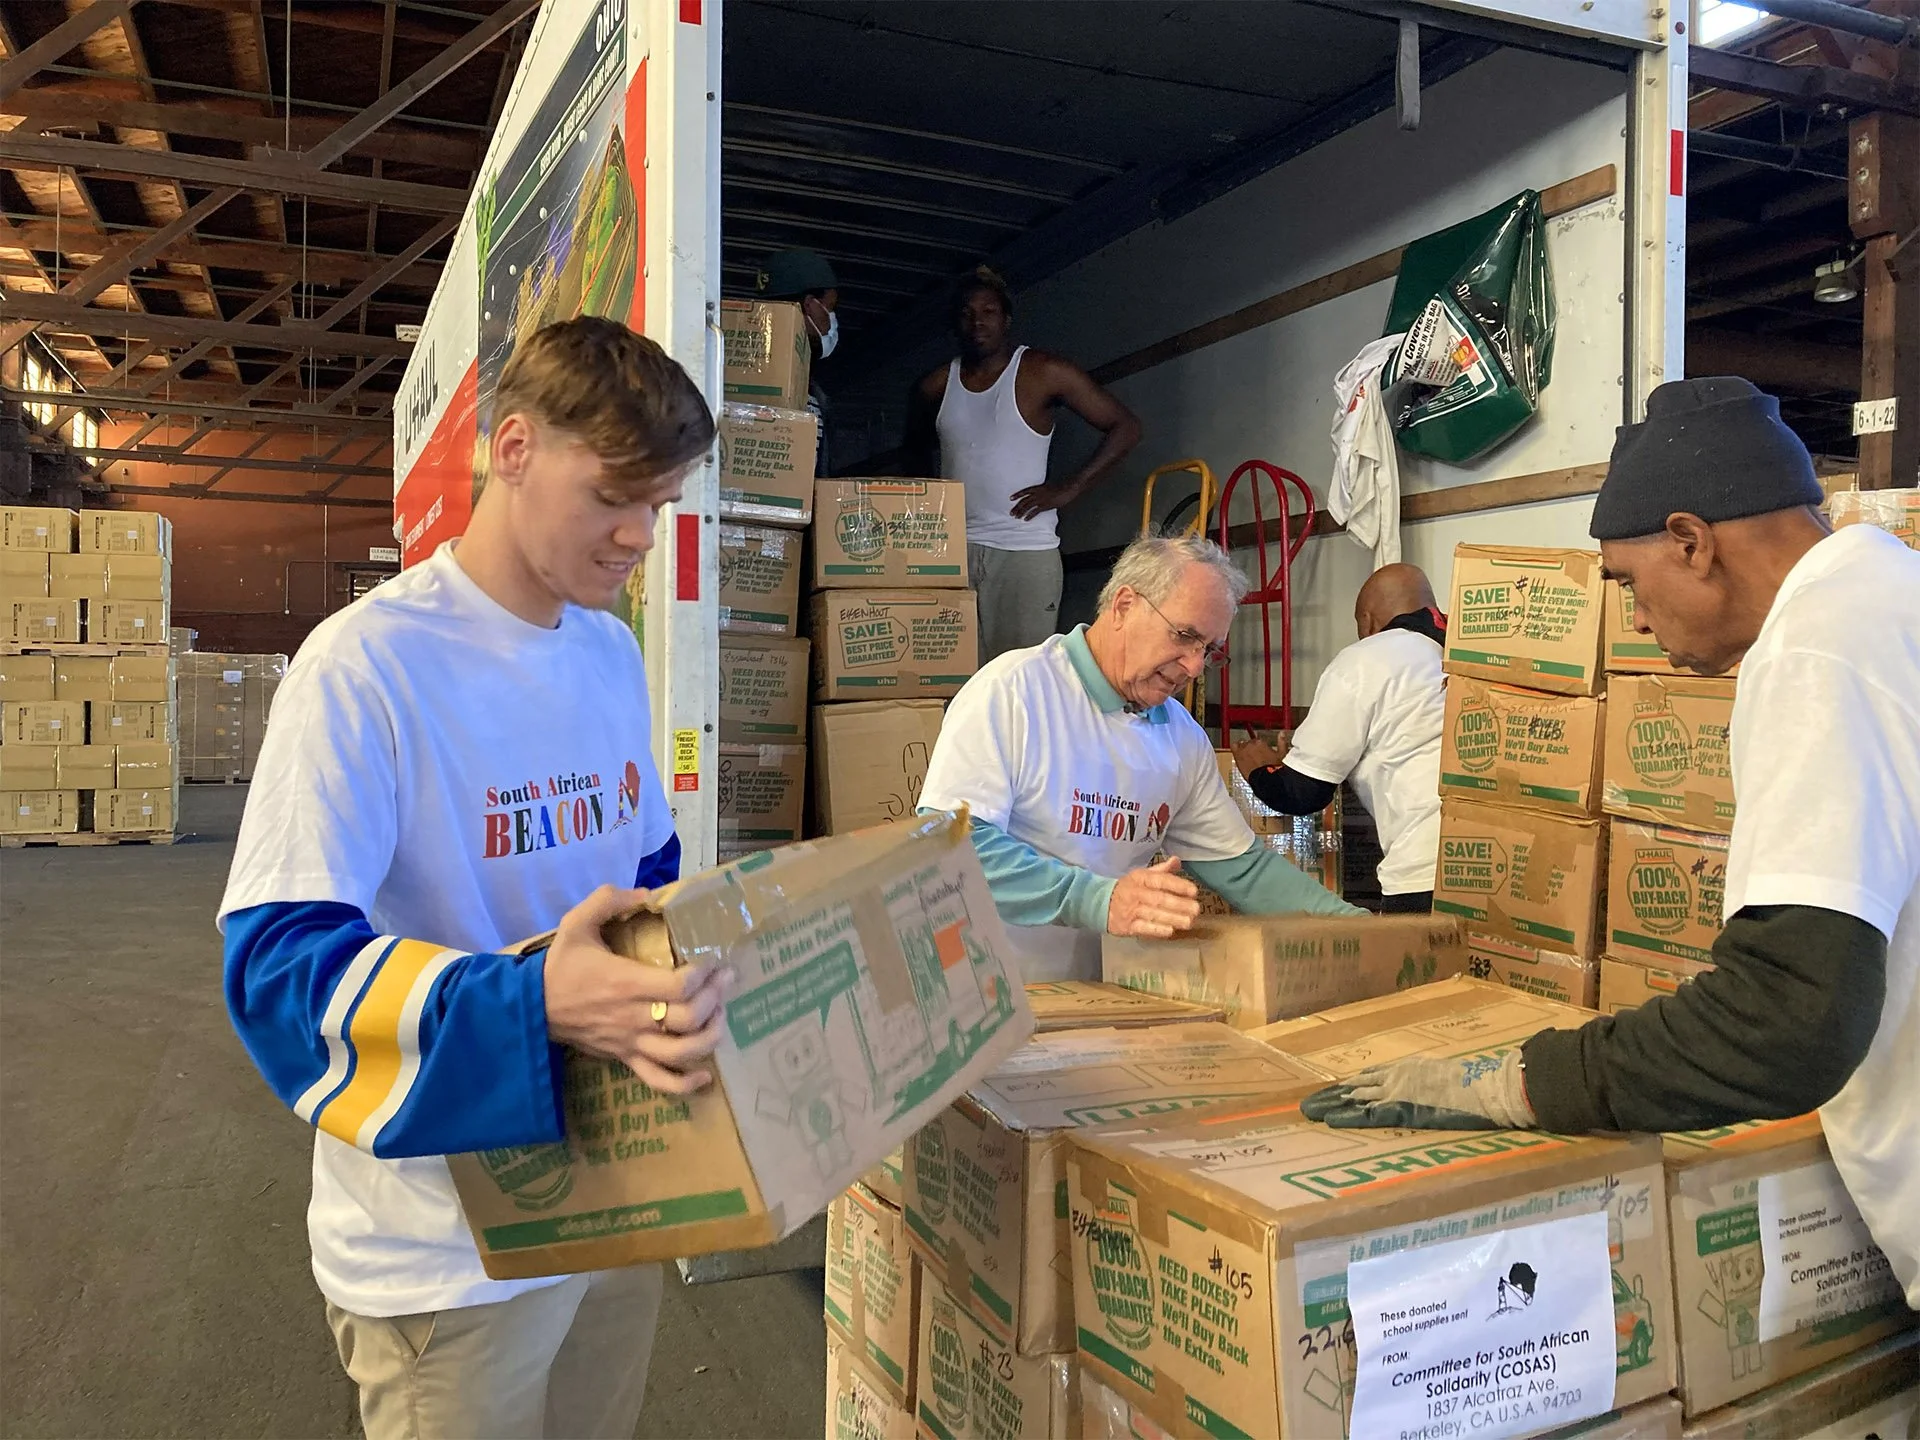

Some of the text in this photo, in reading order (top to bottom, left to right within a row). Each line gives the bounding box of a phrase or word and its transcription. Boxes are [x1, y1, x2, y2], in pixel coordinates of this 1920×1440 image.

[1428, 302, 1438, 317] BAG
[734, 437, 792, 452] NEED BOXES?
[733, 447, 790, 461] TAKE PLENTY!
[747, 468, 777, 480] Extras.
[754, 460, 772, 471] Buy
[773, 462, 795, 472] Back
[1463, 587, 1511, 606] SAVE!
[1548, 596, 1566, 606] EVEN
[1567, 598, 1589, 608] MORE!
[1462, 612, 1483, 623] BEST
[1544, 606, 1555, 614] Our
[1556, 607, 1578, 616] Bundle
[1548, 614, 1560, 623] and
[844, 622, 893, 640] SAVE!
[1462, 623, 1510, 634] GUARANTEED
[1565, 626, 1572, 634] in
[846, 640, 894, 655] BEST PRICE
[1460, 711, 1493, 733] 100%
[1506, 715, 1528, 726] NEED
[1457, 732, 1498, 748] BUY-BACK
[1506, 727, 1526, 738] TAKE
[1634, 719, 1680, 743] 100%
[1458, 746, 1499, 760] GUARANTEE
[1504, 739, 1570, 755] We'll Buy Back
[1504, 751, 1549, 765] the Extras.
[1698, 764, 1716, 777] the
[486, 773, 601, 808] South African
[1073, 788, 1141, 812] South African
[482, 792, 604, 858] BEACON
[1068, 804, 1139, 842] BEACON
[1444, 842, 1492, 859] SAVE!
[1637, 850, 1672, 859] U-HAUL
[1444, 865, 1492, 877] BEST PRICE
[1635, 867, 1681, 889] 100%
[1444, 876, 1492, 889] GUARANTEED
[1632, 890, 1688, 906] BUY-BACK
[1634, 906, 1689, 920] GUARANTEE
[1527, 985, 1545, 997] EVEN
[1546, 988, 1571, 1002] MORE!
[1309, 1135, 1547, 1188] U-HAUL
[1778, 1207, 1827, 1228] These donated
[1350, 1195, 1554, 1263] to Make Packing and Loading
[1779, 1227, 1801, 1240] school
[1802, 1218, 1828, 1235] supplies
[1781, 1250, 1802, 1264] FROM:
[1790, 1249, 1864, 1284] Committee for
[1094, 1263, 1150, 1301] BUY-BACK
[1158, 1253, 1238, 1312] NEED BOXES?
[1815, 1269, 1862, 1292] Solidarity
[1097, 1293, 1155, 1328] GUARANTEE
[1159, 1277, 1240, 1337] TAKE PLENTY!
[1380, 1300, 1448, 1324] These donated
[1383, 1309, 1469, 1339] school supplies sent
[1161, 1300, 1249, 1368] We'll Buy Back
[1162, 1324, 1226, 1377] the Extras.
[1382, 1351, 1411, 1366] FROM:
[1391, 1328, 1590, 1388] Committee for South African
[1426, 1353, 1558, 1399] Solidarity (COSAS)
[971, 1357, 1024, 1414] NEED BOXES?
[972, 1375, 1023, 1435] TAKE PLENTY!
[1427, 1377, 1559, 1420] 1837 Alcatraz Ave.
[1470, 1409, 1495, 1429] CA
[1499, 1403, 1539, 1422] U.S.A.
[1543, 1388, 1582, 1411] 94703
